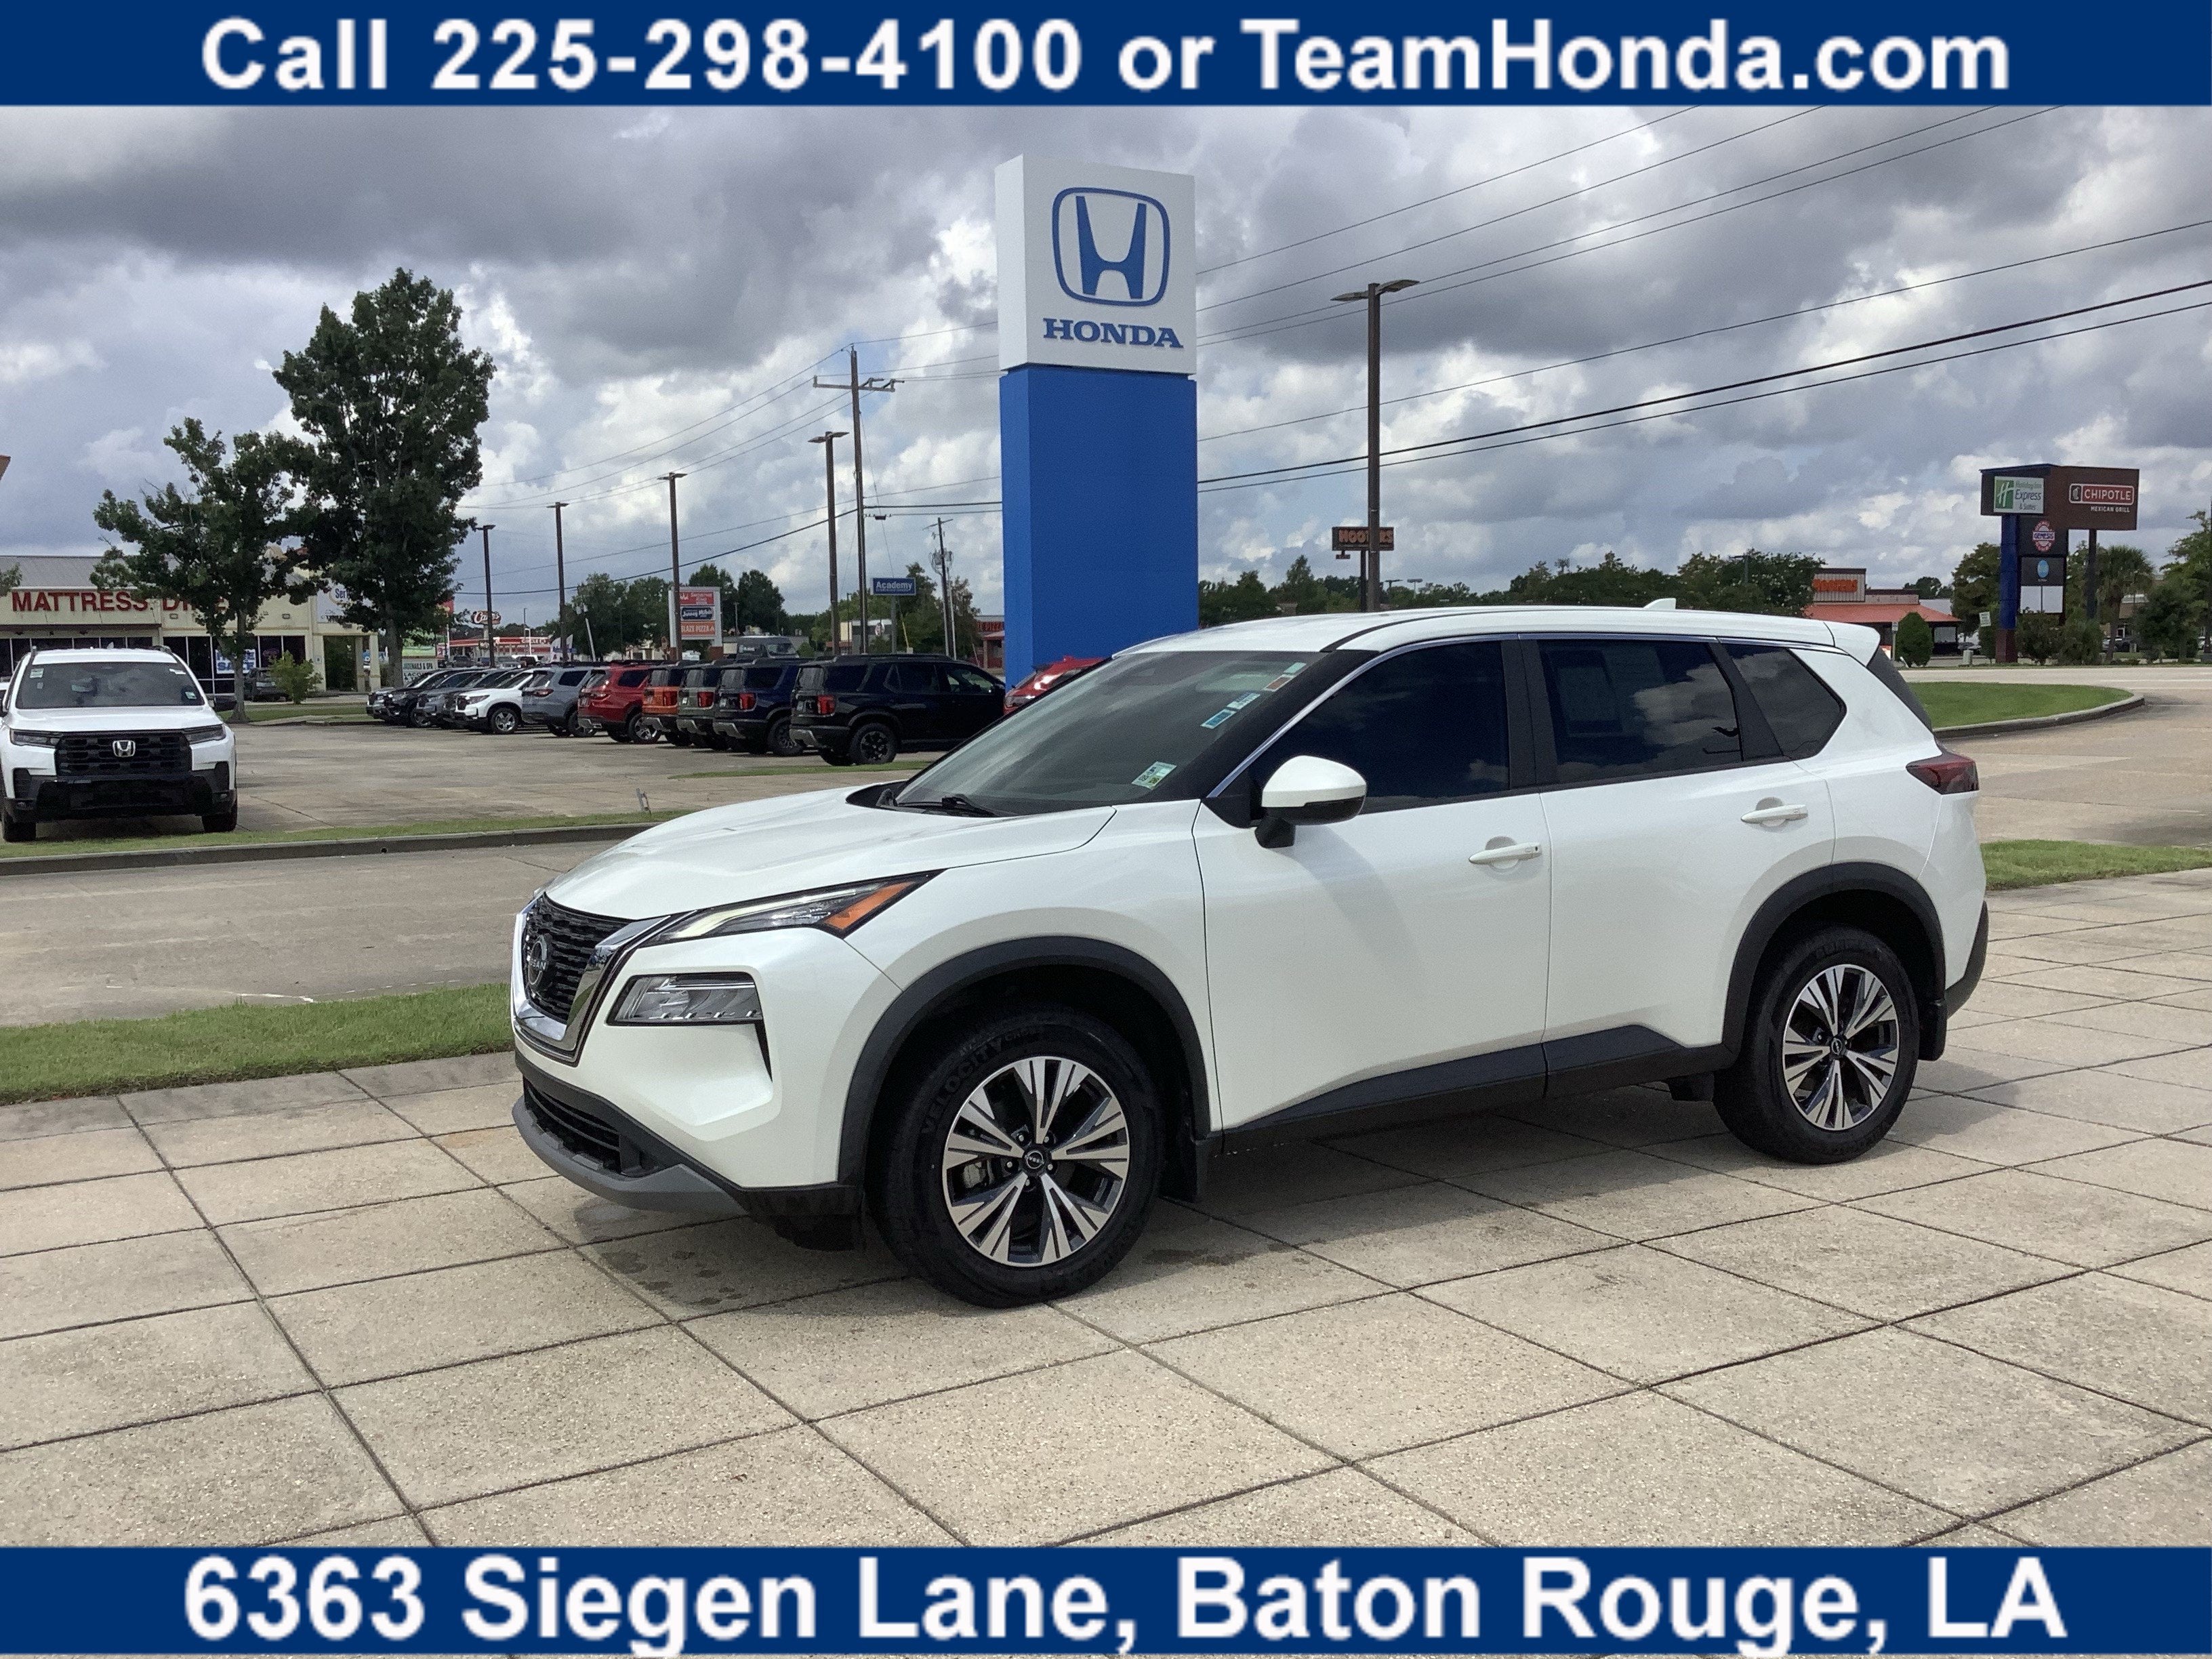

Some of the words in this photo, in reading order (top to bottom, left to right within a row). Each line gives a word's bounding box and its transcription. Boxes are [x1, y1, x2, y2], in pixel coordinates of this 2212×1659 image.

[1043, 318, 1184, 348] HONDA
[2015, 489, 2042, 502] Express
[2084, 489, 2131, 501] CHIPOTLE
[876, 580, 913, 592] Academy
[12, 590, 148, 613] MATTRESS
[695, 625, 710, 633] PIZZA
